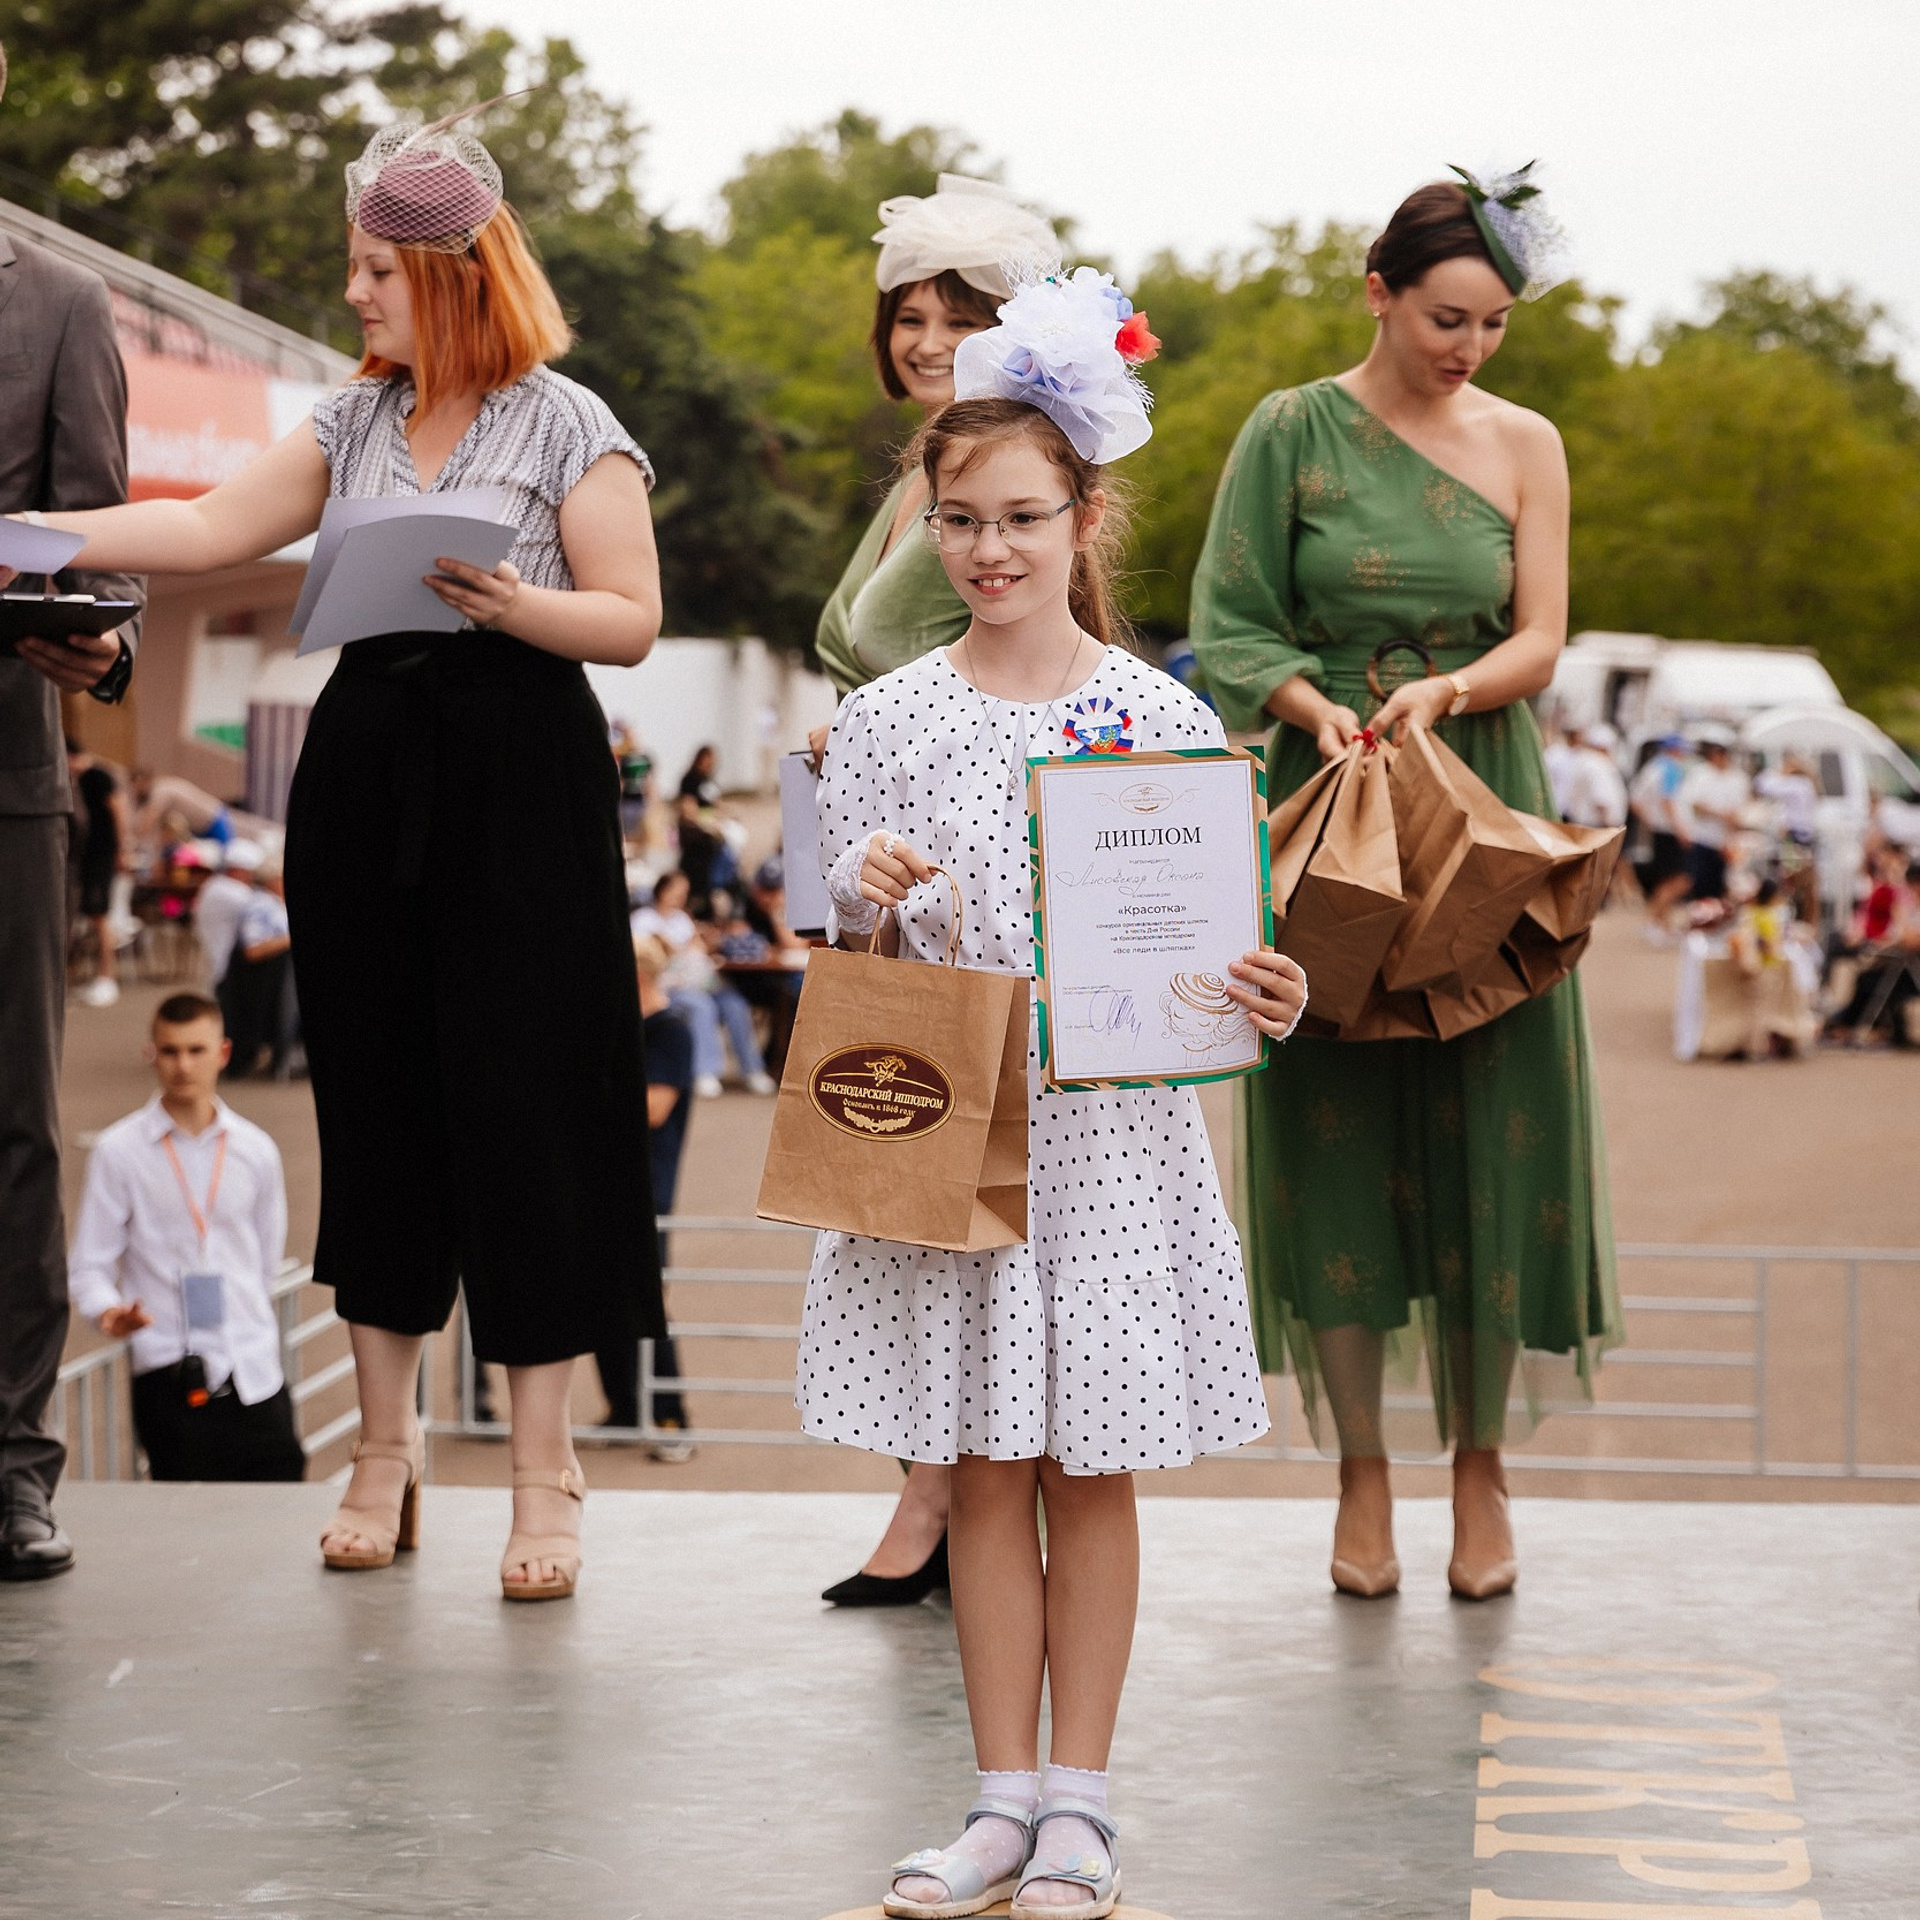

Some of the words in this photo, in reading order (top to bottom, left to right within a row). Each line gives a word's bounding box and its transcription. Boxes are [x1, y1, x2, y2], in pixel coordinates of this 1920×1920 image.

[1095, 826, 1202, 851] ДИПЛОМ
[1118, 904, 1187, 915] «Красотка»
[1132, 946, 1152, 954] леди
[819, 1081, 893, 1102] КРАСНОДАРСКИЙ
[894, 1092, 945, 1110] ИППОДРОМ
